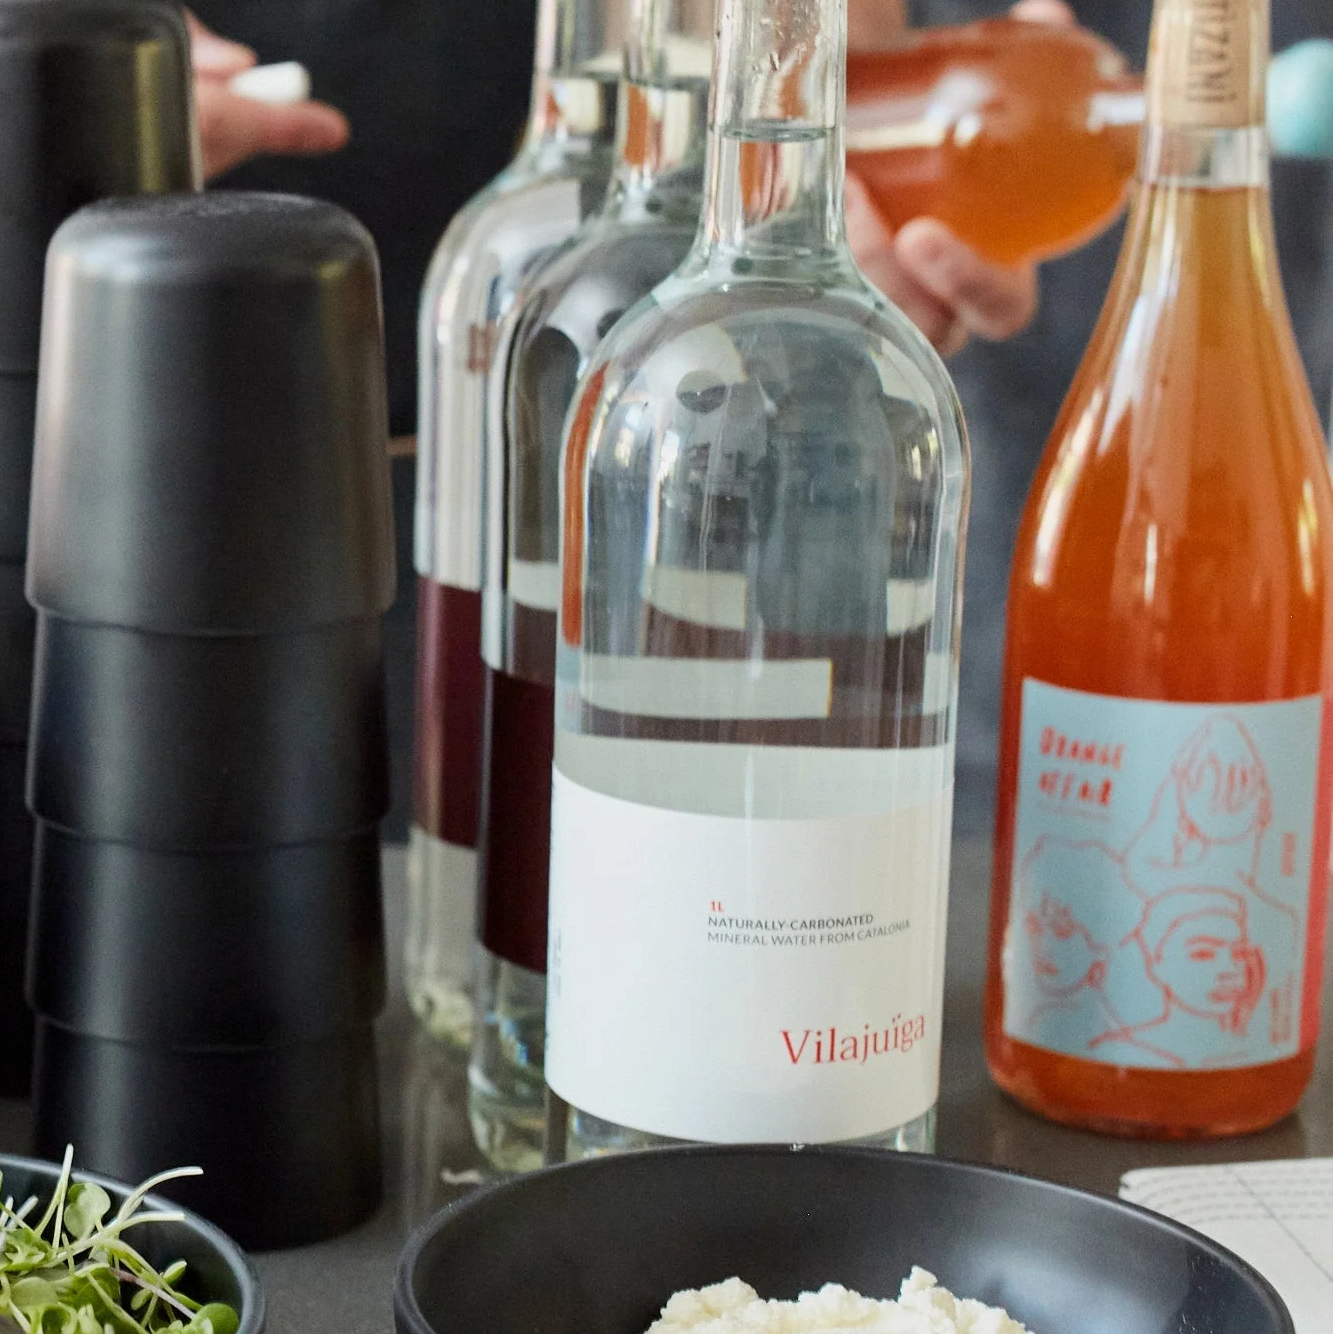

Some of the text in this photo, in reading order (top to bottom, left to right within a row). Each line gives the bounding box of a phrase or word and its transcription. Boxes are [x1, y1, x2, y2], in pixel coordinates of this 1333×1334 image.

[707, 931, 768, 946] MINERAL
[771, 934, 816, 946] WATER
[820, 931, 854, 944] FROM
[780, 1013, 926, 1066] Vilajuïga
